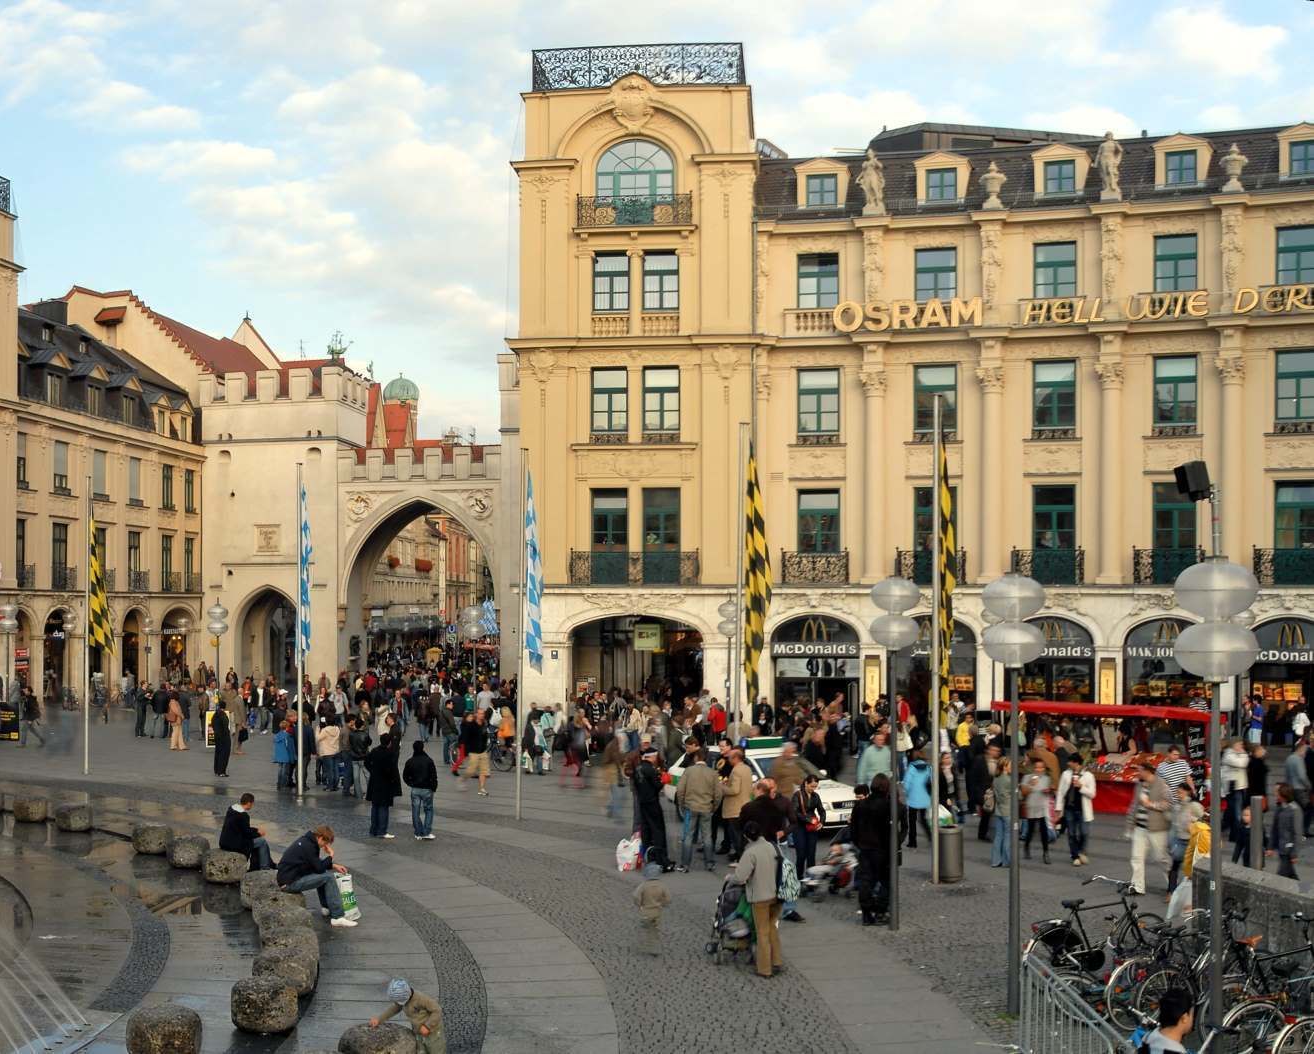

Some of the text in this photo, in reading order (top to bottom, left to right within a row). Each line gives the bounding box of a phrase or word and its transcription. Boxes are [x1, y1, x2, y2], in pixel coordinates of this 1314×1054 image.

[833, 285, 1314, 332] OSRAM HELL WIE DER
[773, 643, 857, 654] McDonald's
[1040, 646, 1092, 657] onald's
